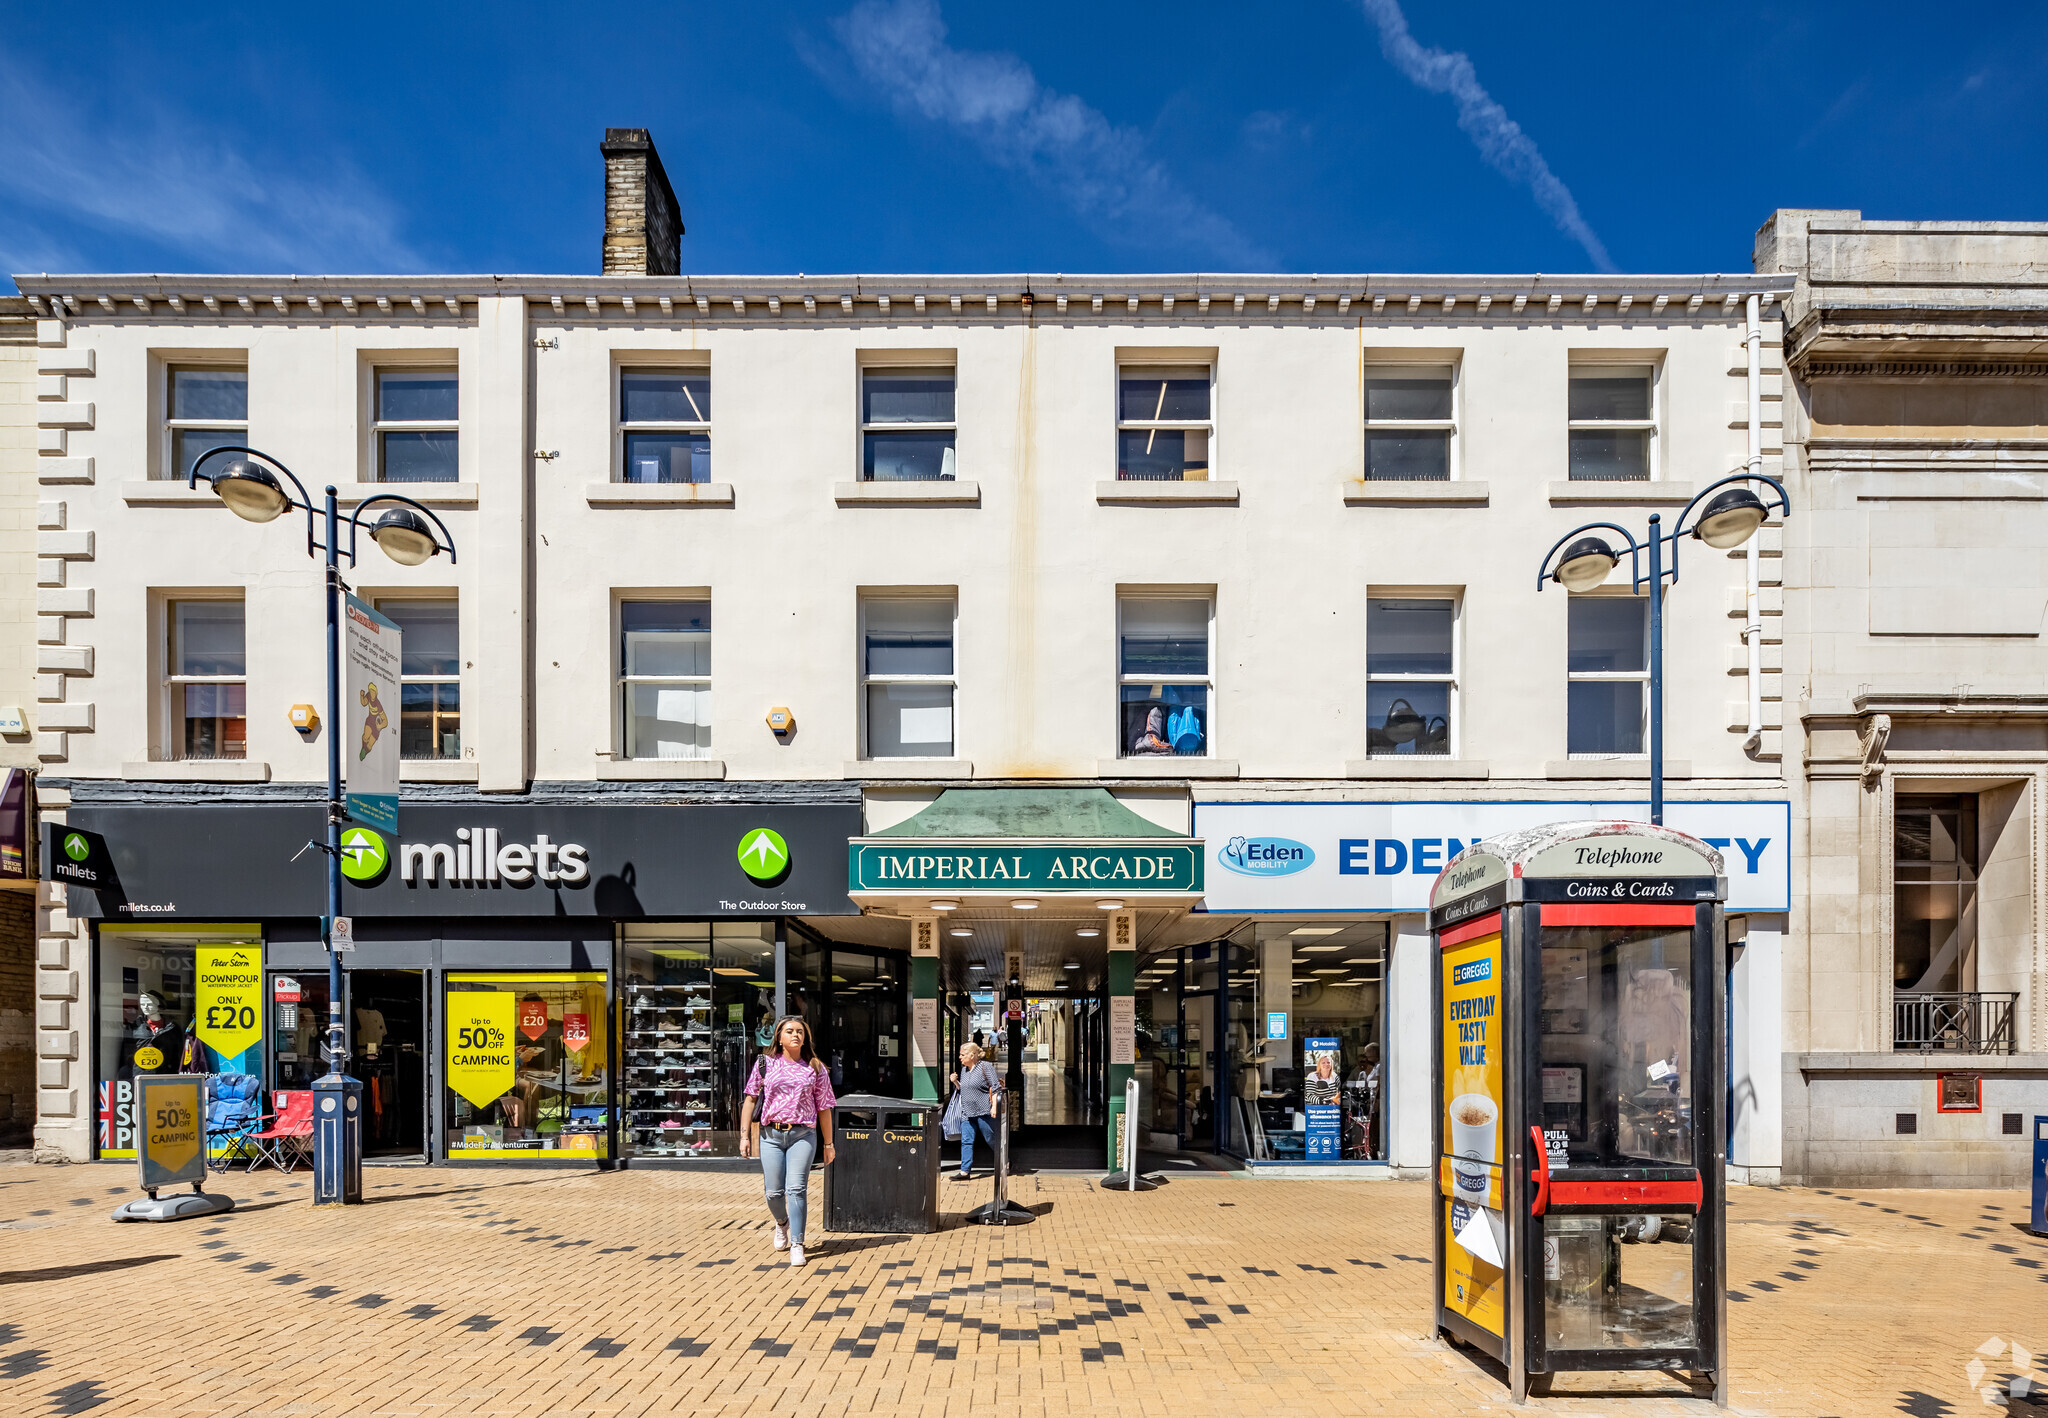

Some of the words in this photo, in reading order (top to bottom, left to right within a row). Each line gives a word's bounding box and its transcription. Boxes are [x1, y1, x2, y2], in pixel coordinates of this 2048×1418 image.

[401, 828, 589, 881] millets
[1247, 843, 1304, 861] Eden
[1574, 847, 1663, 867] Telephone
[3, 864, 23, 873] BANK
[877, 856, 1031, 880] IMPERIAL
[1046, 855, 1176, 880] ARCADE
[1247, 860, 1288, 869] MOBILITY
[56, 863, 97, 881] millets
[1451, 865, 1486, 890] Telephone
[1567, 882, 1608, 897] Coins
[1611, 882, 1626, 897] &
[1629, 881, 1675, 897] Cards
[119, 902, 176, 913] millets.co.uk
[719, 900, 737, 910] The
[739, 900, 779, 910] Outdoor
[781, 900, 806, 910] Store
[1445, 906, 1462, 921] Coins
[1463, 901, 1470, 915] &
[1470, 894, 1489, 913] Cards
[211, 958, 229, 967] Peter
[230, 958, 250, 967] Storm
[1461, 961, 1490, 980] GREGGS
[201, 974, 259, 983] DOWNPOUR
[217, 995, 243, 1004] ONLY
[276, 993, 298, 1001] Pickup
[1450, 994, 1496, 1021] EVERYDAY
[206, 1006, 256, 1029] £20
[471, 1018, 481, 1026] Up
[523, 1016, 544, 1026] £20
[566, 1030, 586, 1040] £42
[1458, 1020, 1487, 1043] TASTY
[457, 1027, 505, 1049] 50%
[488, 1041, 504, 1049] OFF
[452, 1055, 510, 1066] CAMPING
[1459, 1044, 1487, 1066] VALUE
[141, 1058, 158, 1066] £20
[155, 1108, 191, 1129] 50%
[179, 1119, 191, 1128] OFF
[151, 1131, 196, 1145] CAMPING
[846, 1131, 870, 1140] Litter
[897, 1133, 923, 1143] recycle
[1544, 1130, 1568, 1139] PULL
[451, 1141, 529, 1149] #MadeForAdventure
[1460, 1175, 1485, 1189] GREGGS
